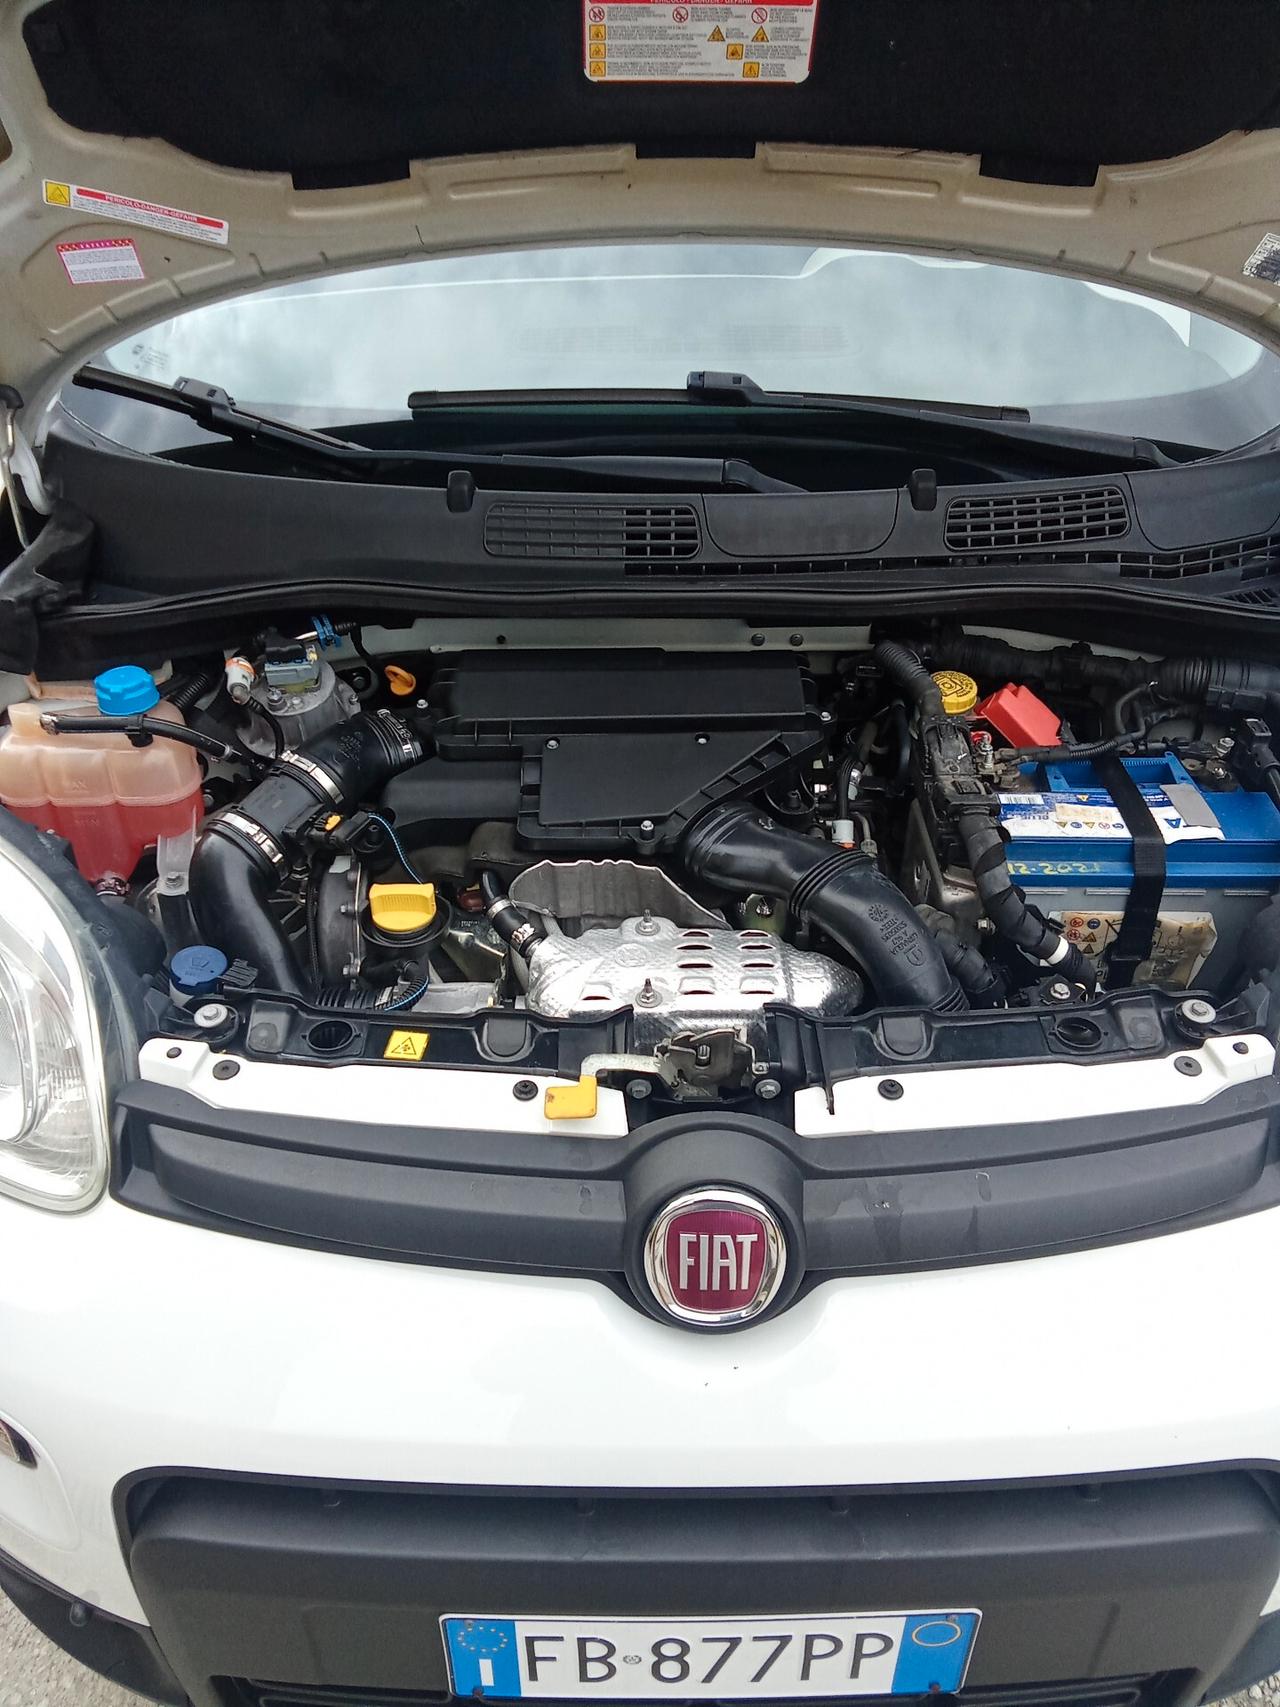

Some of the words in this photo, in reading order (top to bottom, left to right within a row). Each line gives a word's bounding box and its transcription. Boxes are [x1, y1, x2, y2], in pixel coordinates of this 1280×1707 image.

[679, 1233, 758, 1291] FIAT
[525, 1636, 617, 1683] FB
[651, 1633, 894, 1684] 877PP
